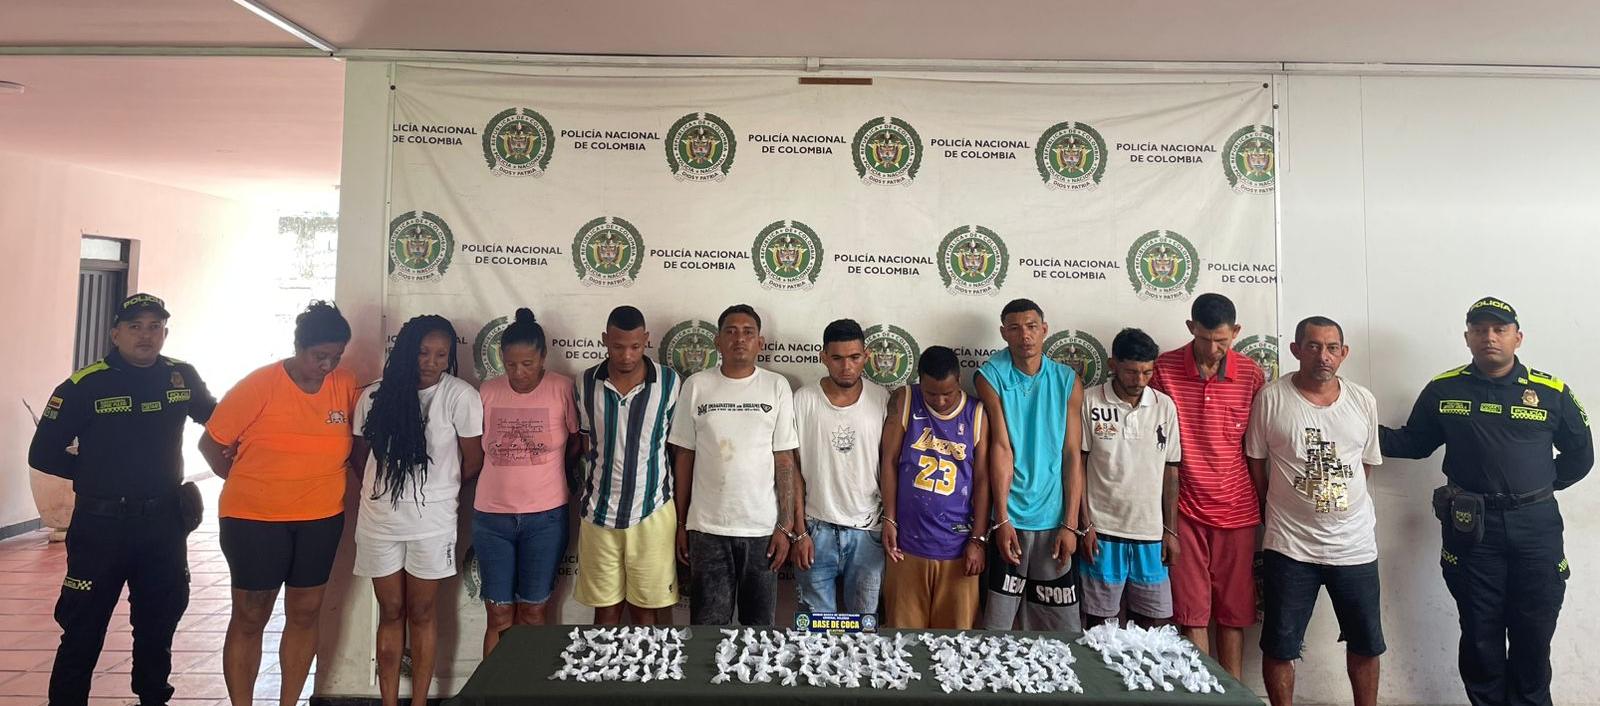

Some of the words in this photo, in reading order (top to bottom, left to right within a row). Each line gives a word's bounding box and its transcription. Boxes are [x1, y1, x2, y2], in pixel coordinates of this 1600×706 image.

[393, 122, 418, 132] LICÍA
[421, 125, 477, 135] NACIONAL
[530, 118, 546, 147] COLOMBIA
[561, 128, 602, 138] POLICÍA
[605, 131, 660, 140] NACIONAL
[392, 134, 404, 143] DE
[407, 136, 462, 145] COLOMBIA
[712, 123, 727, 152] COLOMBIA
[748, 133, 789, 142] POLICÍA
[792, 135, 846, 144] NACIONAL
[898, 127, 914, 156] COLOMBIA
[931, 137, 972, 147] POLICÍA
[974, 140, 1030, 148] NACIONAL
[590, 142, 646, 150] COLOMBIA
[778, 146, 832, 154] COLOMBIA
[1082, 132, 1098, 161] COLOMBIA
[1116, 142, 1158, 151] POLICÍA
[1161, 144, 1216, 152] NACIONAL
[960, 150, 1016, 159] COLOMBIA
[1130, 154, 1144, 162] DE
[1146, 155, 1203, 163] COLOMBIA
[620, 228, 635, 256] COLOMBIA
[798, 231, 814, 260] COLOMBIA
[462, 243, 503, 253] POLICÍA
[506, 246, 562, 254] NACIONAL
[650, 248, 692, 258] POLICÍA
[694, 250, 750, 259] NACIONAL
[475, 256, 489, 264] DE
[491, 256, 548, 266] COLOMBIA
[834, 253, 876, 263] POLICÍA
[878, 255, 934, 264] NACIONAL
[1019, 257, 1061, 267] POLICÍA
[1064, 260, 1120, 268] NACIONAL
[664, 261, 677, 269] DE
[680, 261, 736, 270] COLOMBIA
[848, 266, 861, 274] DE
[864, 266, 920, 275] COLOMBIA
[1208, 262, 1250, 272] POLICÍA
[1033, 270, 1047, 278] DE
[1050, 270, 1106, 280] COLOMBIA
[1222, 275, 1235, 283] DE
[1238, 275, 1277, 284] COLOM
[552, 338, 594, 347] POLICÍA
[764, 342, 785, 351] ICÍA
[788, 344, 822, 352] NACIO
[566, 351, 579, 359] DE
[758, 354, 770, 362] DE
[774, 355, 821, 363] COLOMBI
[1091, 408, 1118, 422] SUI
[914, 455, 957, 496] 23
[1036, 585, 1076, 604] SPORT
[812, 620, 830, 628] BASE
[831, 620, 840, 629] DE
[841, 620, 860, 629] COCA
